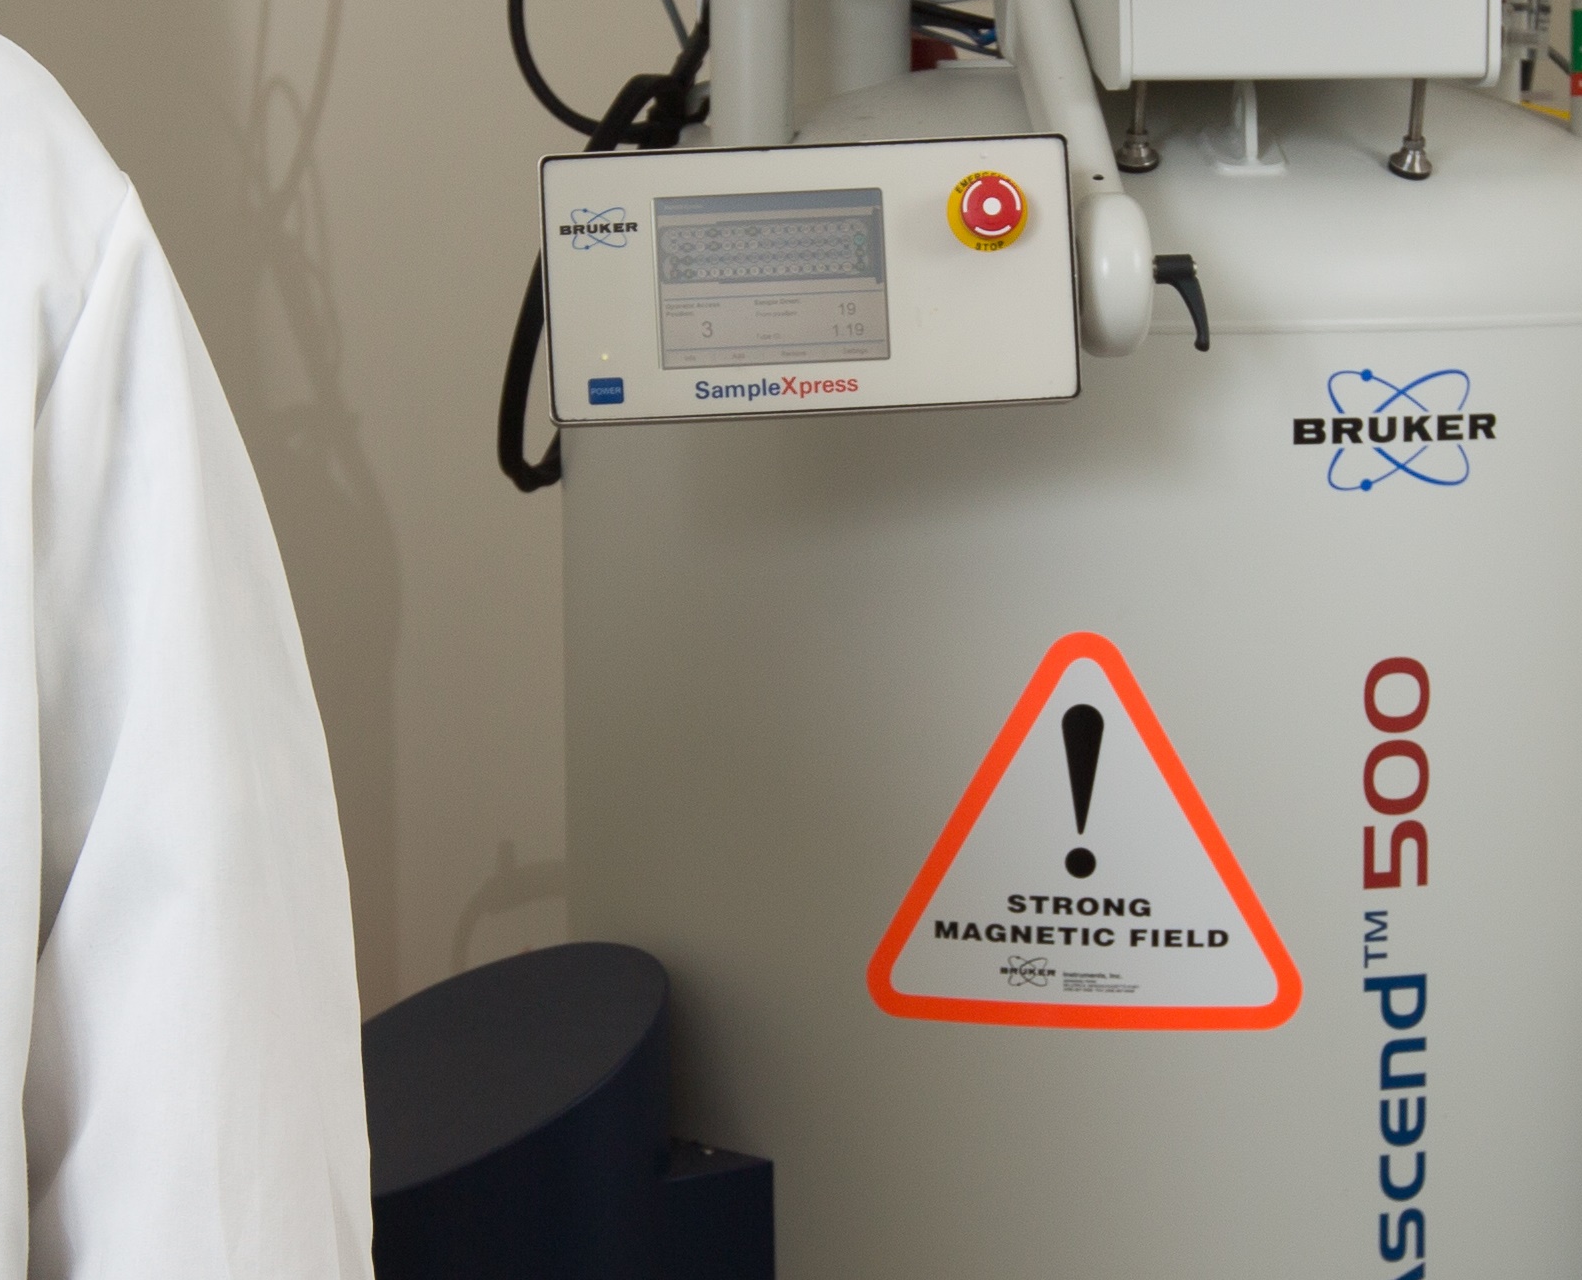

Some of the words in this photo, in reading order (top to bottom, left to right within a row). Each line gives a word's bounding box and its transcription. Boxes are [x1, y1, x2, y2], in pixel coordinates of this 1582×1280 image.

[558, 221, 639, 236] BRUKER
[975, 240, 1005, 252] STOP
[838, 302, 857, 316] 19
[701, 320, 714, 339] 3
[590, 386, 622, 396] POWER
[694, 376, 859, 401] SampleXpress
[1292, 412, 1497, 446] BRUKER
[1363, 657, 1431, 890] 500
[1006, 893, 1153, 918] STRONG
[933, 920, 1116, 948] MAGNETIC
[1129, 928, 1230, 948] FIELD
[999, 966, 1057, 977] BRUKER
